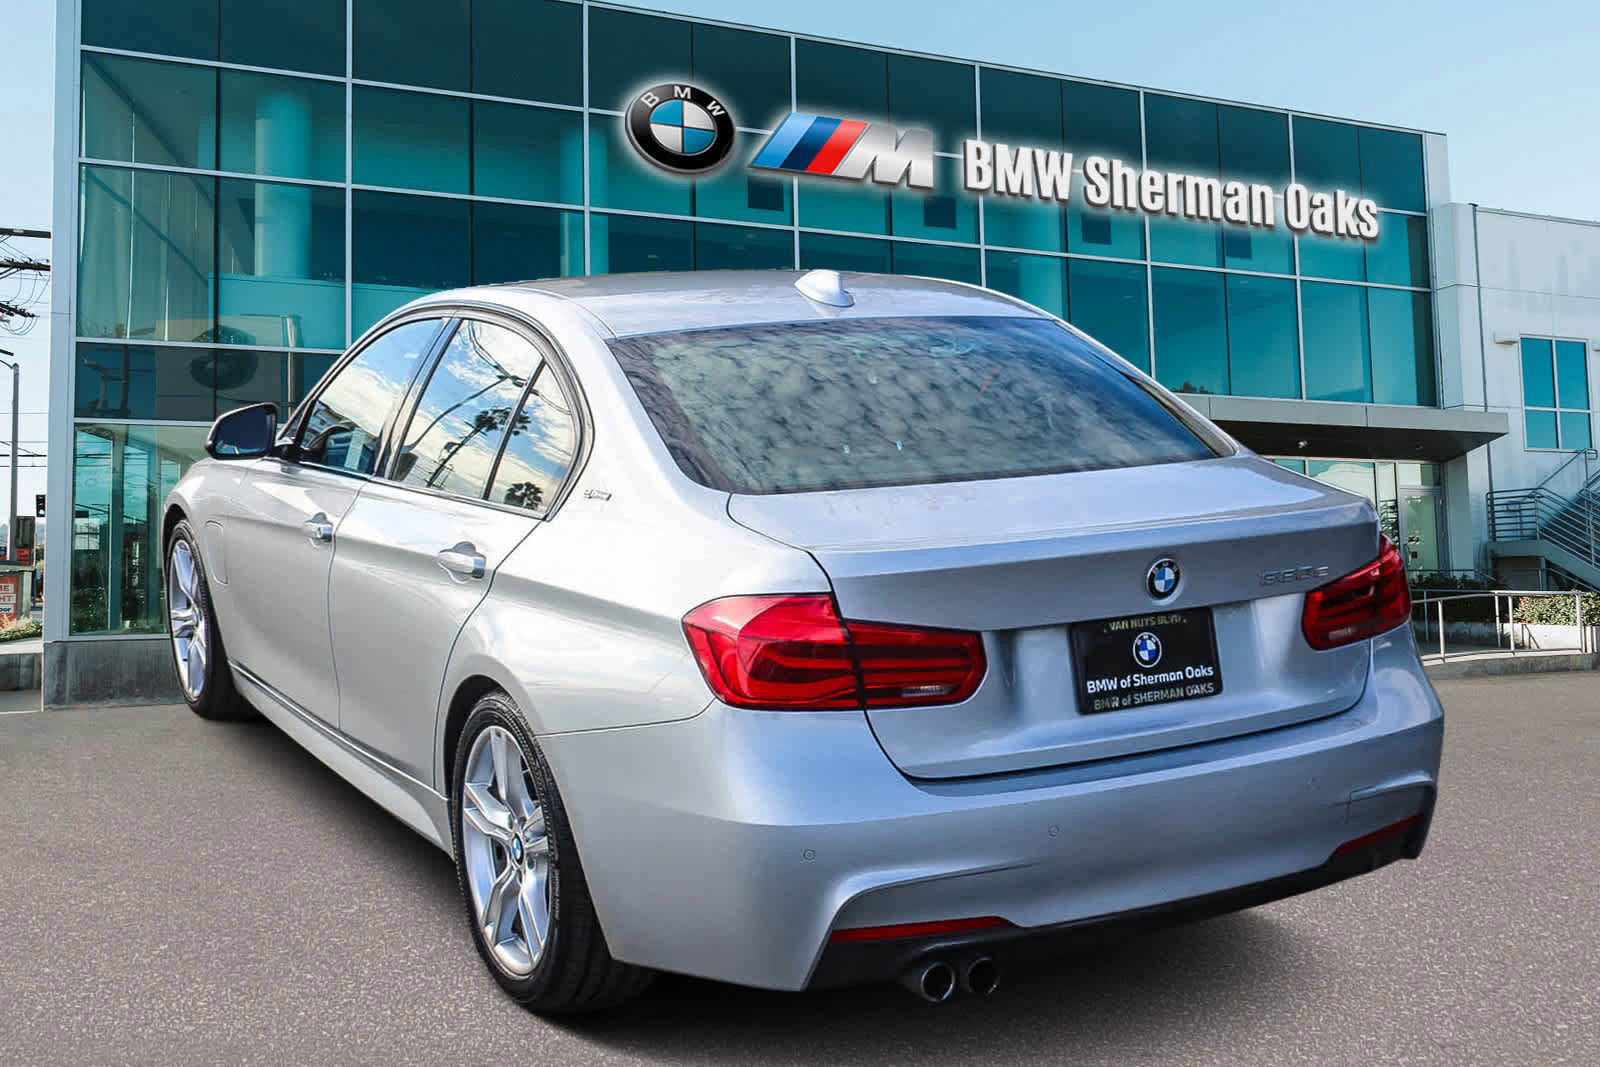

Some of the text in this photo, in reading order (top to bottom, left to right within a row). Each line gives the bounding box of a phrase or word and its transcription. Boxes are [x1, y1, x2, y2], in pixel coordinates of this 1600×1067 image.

[964, 140, 1379, 240] BMW Sherman Oaks
[1109, 620, 1129, 631] VAN
[1087, 665, 1214, 694] BMW of Sherman Oaks
[1094, 696, 1120, 710] BMW
[1134, 688, 1184, 705] SHERMAN
[1186, 683, 1214, 697] OAKS
